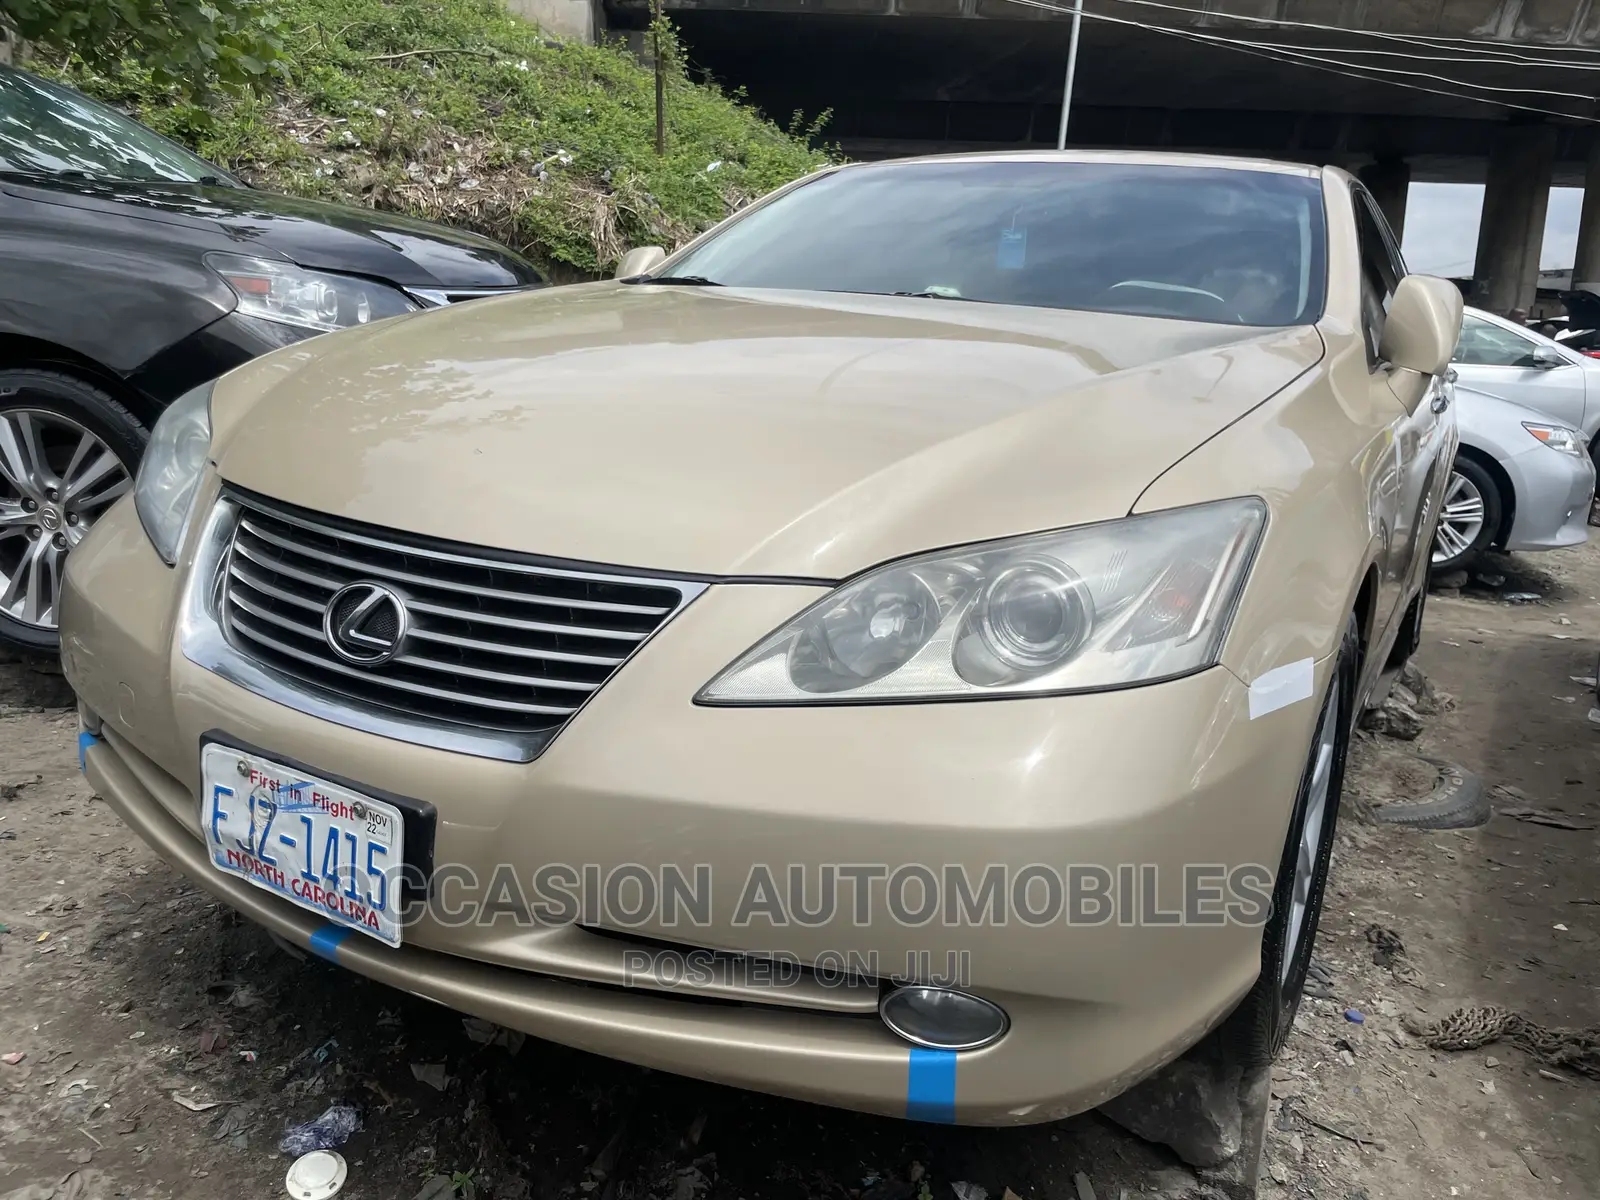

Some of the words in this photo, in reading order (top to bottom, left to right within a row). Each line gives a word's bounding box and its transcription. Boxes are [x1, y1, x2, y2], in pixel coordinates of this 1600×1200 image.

[250, 770, 281, 793] First
[290, 784, 301, 801] in
[313, 792, 355, 820] Flight
[367, 822, 377, 834] 22
[369, 812, 388, 827] NOV
[227, 849, 285, 888] NORTH
[291, 879, 381, 930] CAROLINA
